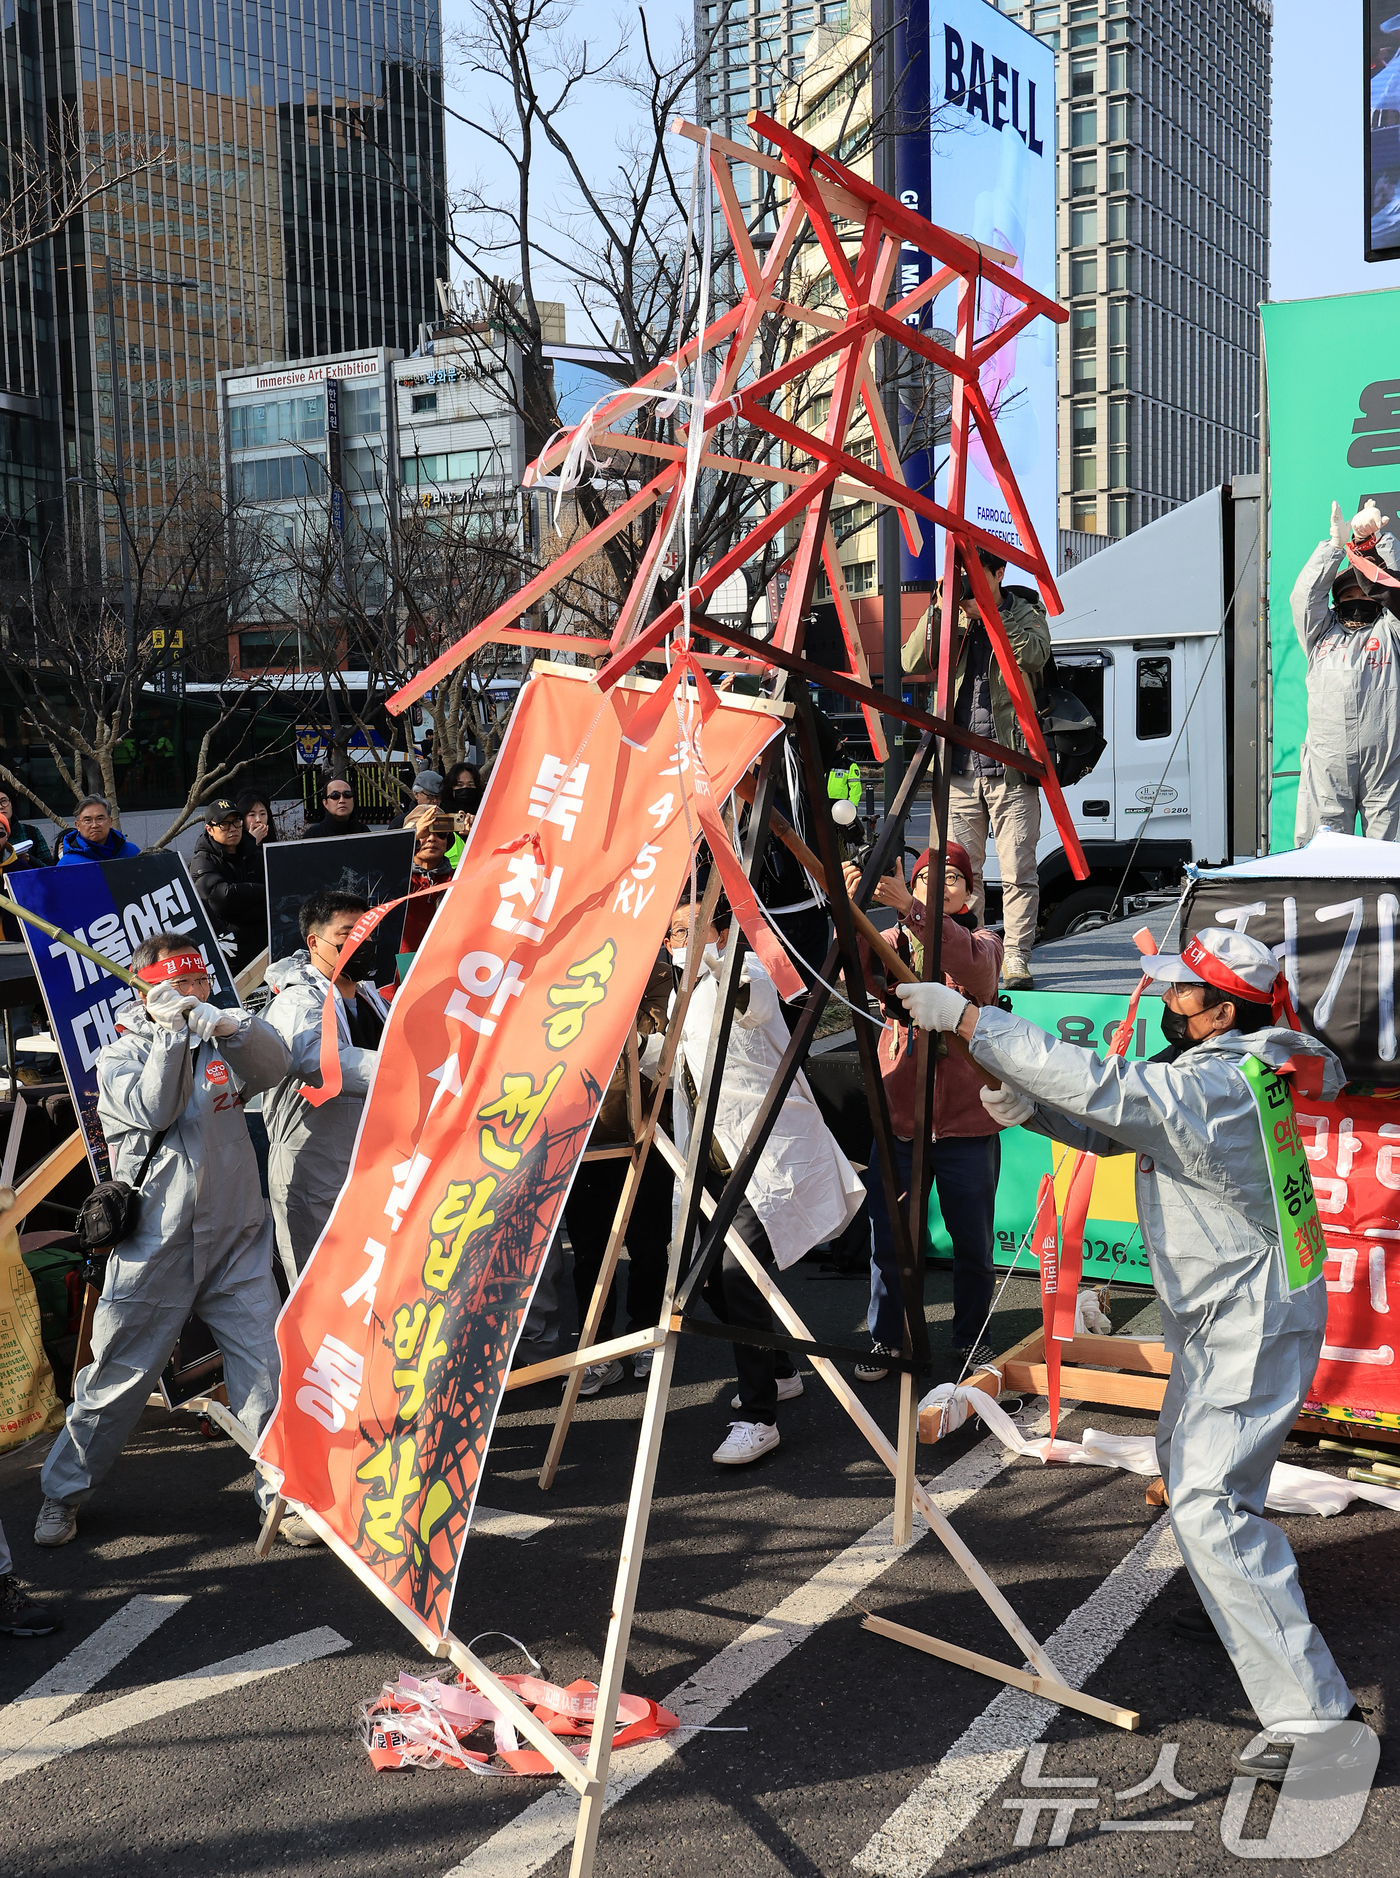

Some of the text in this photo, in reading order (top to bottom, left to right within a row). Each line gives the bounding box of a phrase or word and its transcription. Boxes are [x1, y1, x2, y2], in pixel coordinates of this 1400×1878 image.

[944, 22, 1043, 158] BAELL
[256, 362, 377, 389] Immersive Art Exhibition
[328, 389, 337, 429] 한의원
[977, 506, 1015, 524] FARRO GLO
[443, 753, 590, 1037] 북천안
[48, 877, 198, 993] 기울어진
[1042, 1235, 1057, 1295] 결사반대
